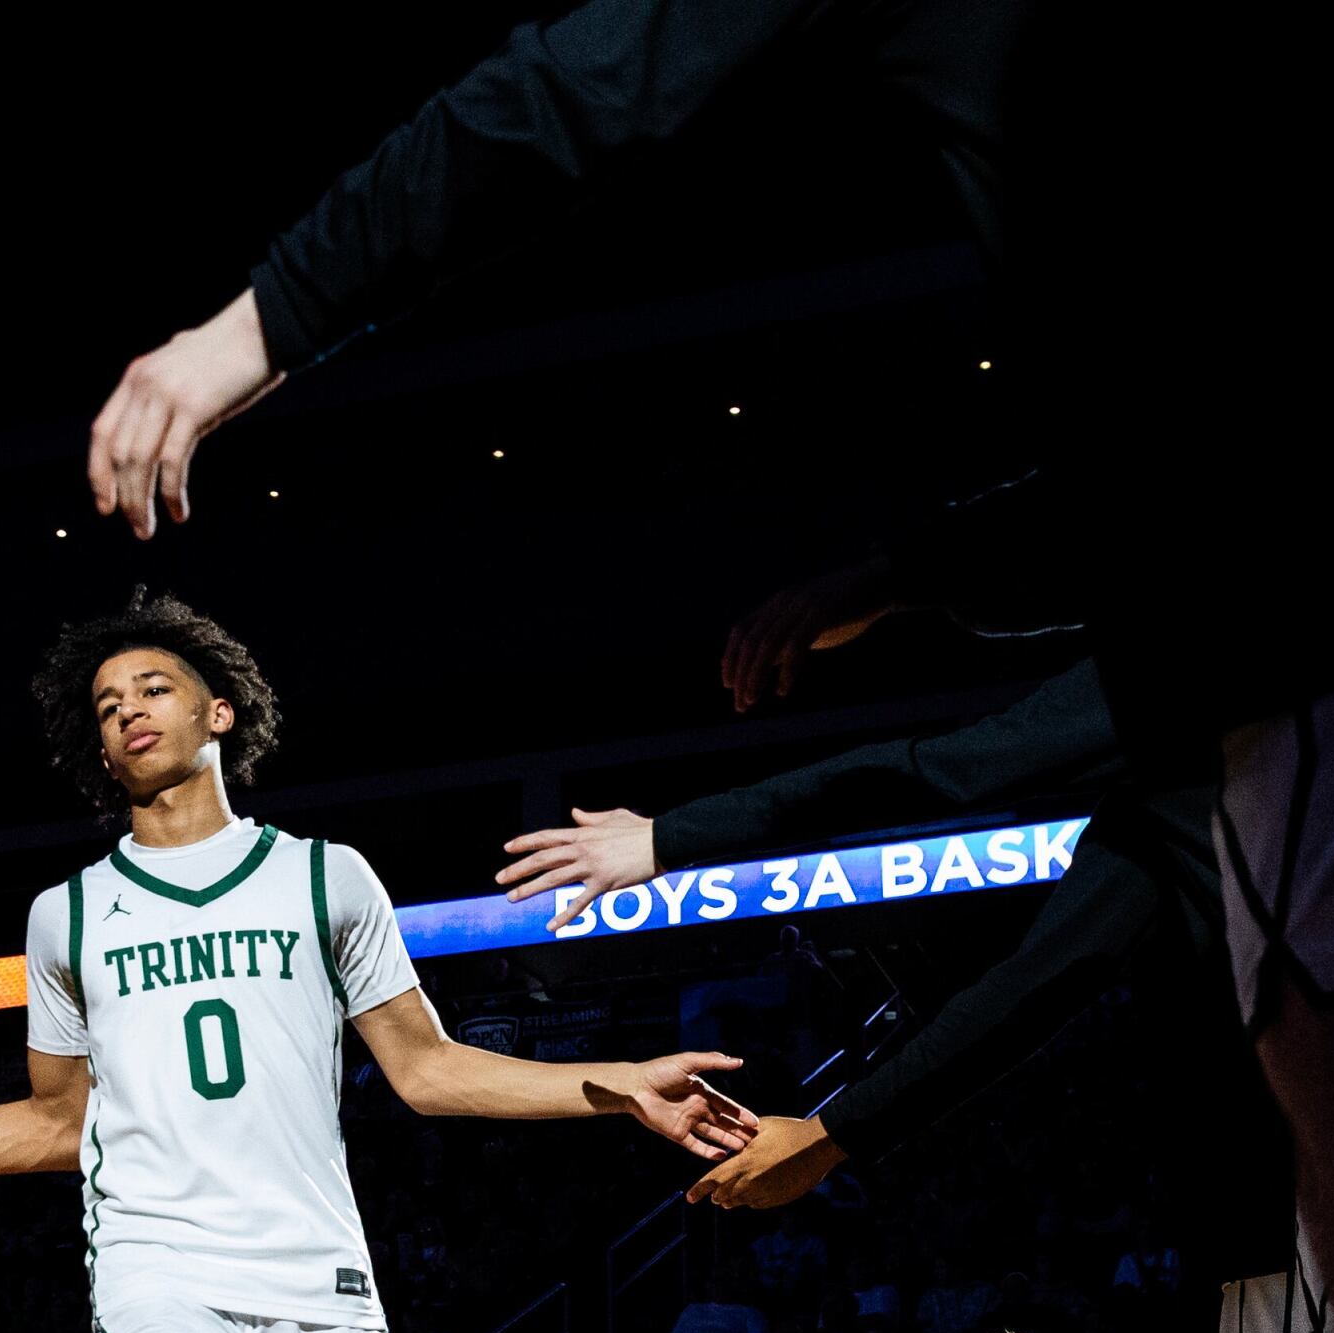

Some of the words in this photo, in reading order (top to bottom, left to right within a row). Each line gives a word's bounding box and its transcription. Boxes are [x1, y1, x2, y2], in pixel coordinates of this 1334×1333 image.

[555, 867, 737, 939] BOYS
[761, 853, 857, 912] 3A
[104, 929, 300, 997] TRINITY
[183, 998, 246, 1101] 0
